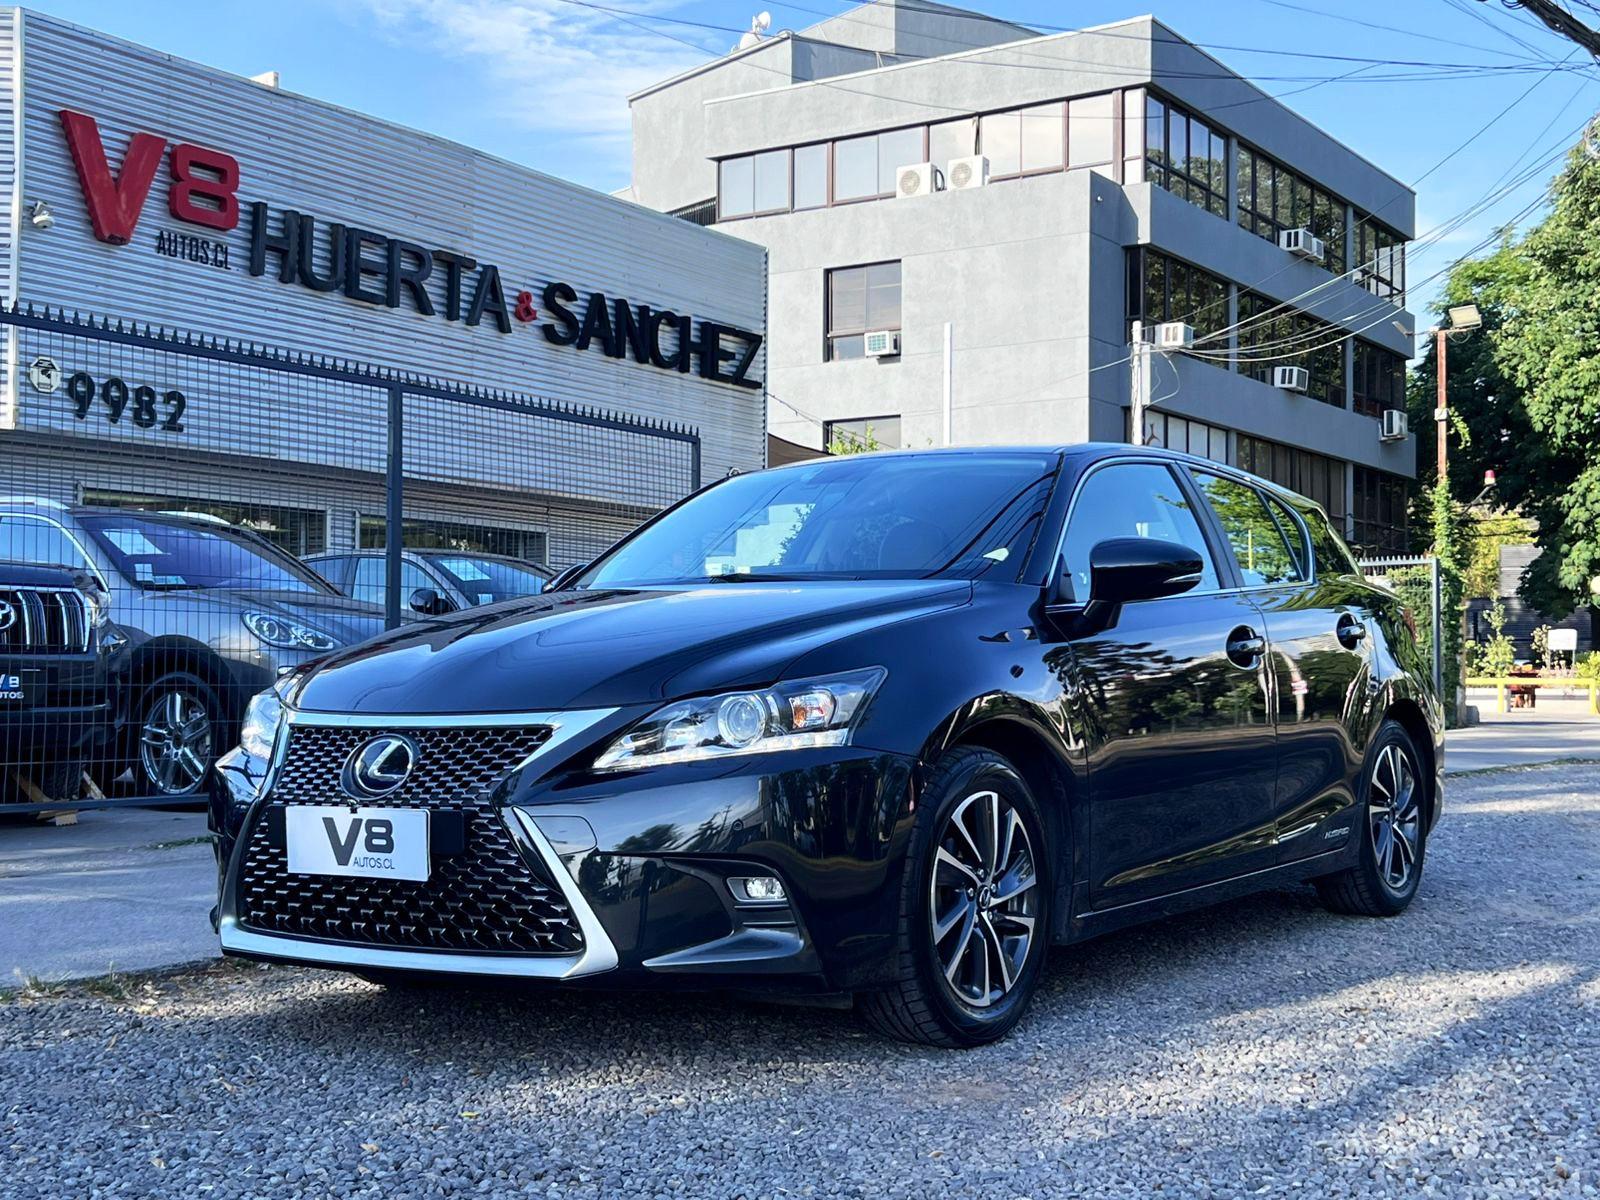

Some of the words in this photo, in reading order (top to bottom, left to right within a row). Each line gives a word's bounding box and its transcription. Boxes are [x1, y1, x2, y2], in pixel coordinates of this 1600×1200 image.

[59, 109, 240, 246] V8
[156, 229, 232, 270] AUTOS.CL
[250, 201, 512, 334] HUERTA
[514, 290, 538, 323] &
[542, 282, 763, 389] SANCHEZ
[67, 372, 187, 433] 9982
[322, 816, 395, 867] V8
[353, 856, 395, 870] AUTOS.CL
